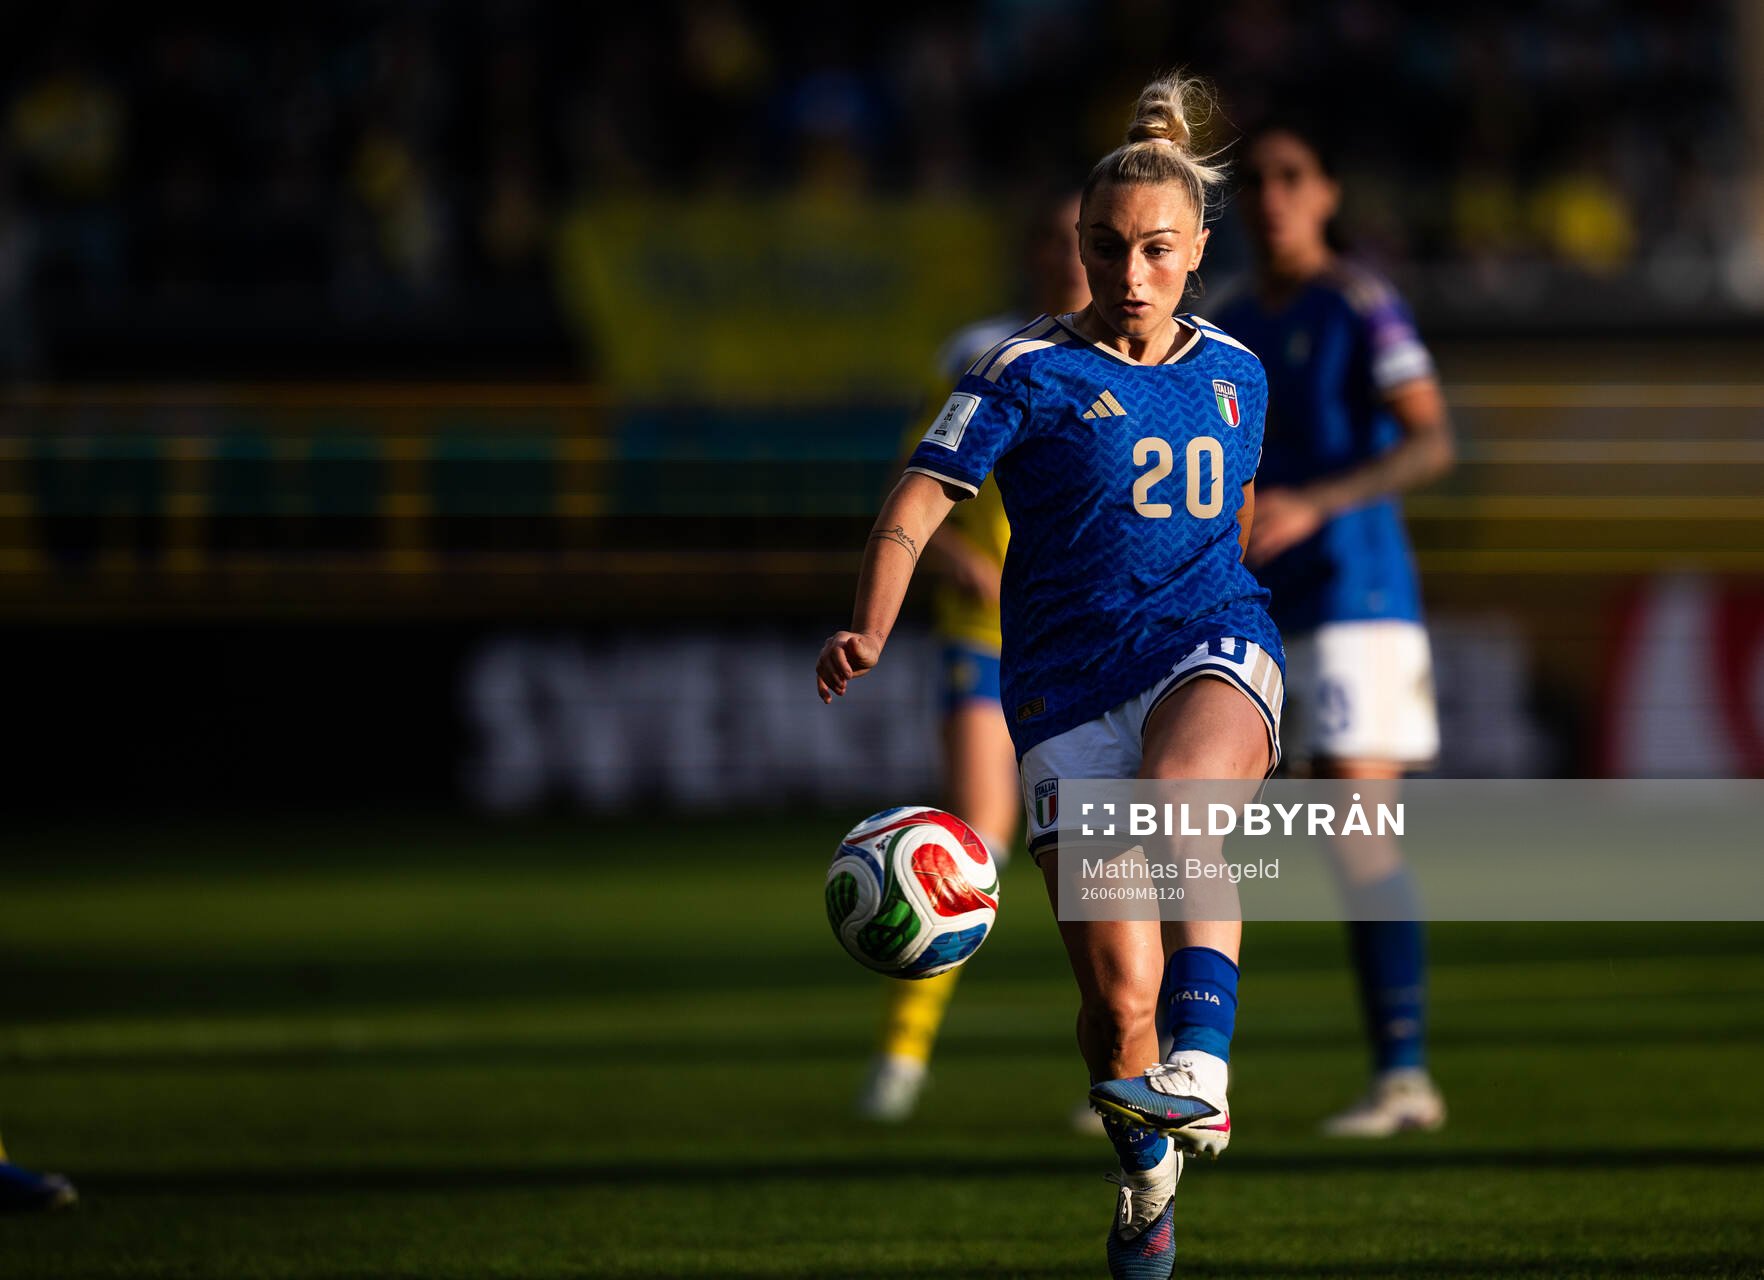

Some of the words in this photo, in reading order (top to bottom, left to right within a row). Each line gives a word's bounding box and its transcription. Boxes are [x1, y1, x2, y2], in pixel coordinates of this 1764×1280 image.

[1214, 382, 1236, 396] ITALIA
[1132, 436, 1224, 519] 20
[1035, 780, 1057, 796] ITALIA
[1170, 990, 1220, 1006] ITALIA
